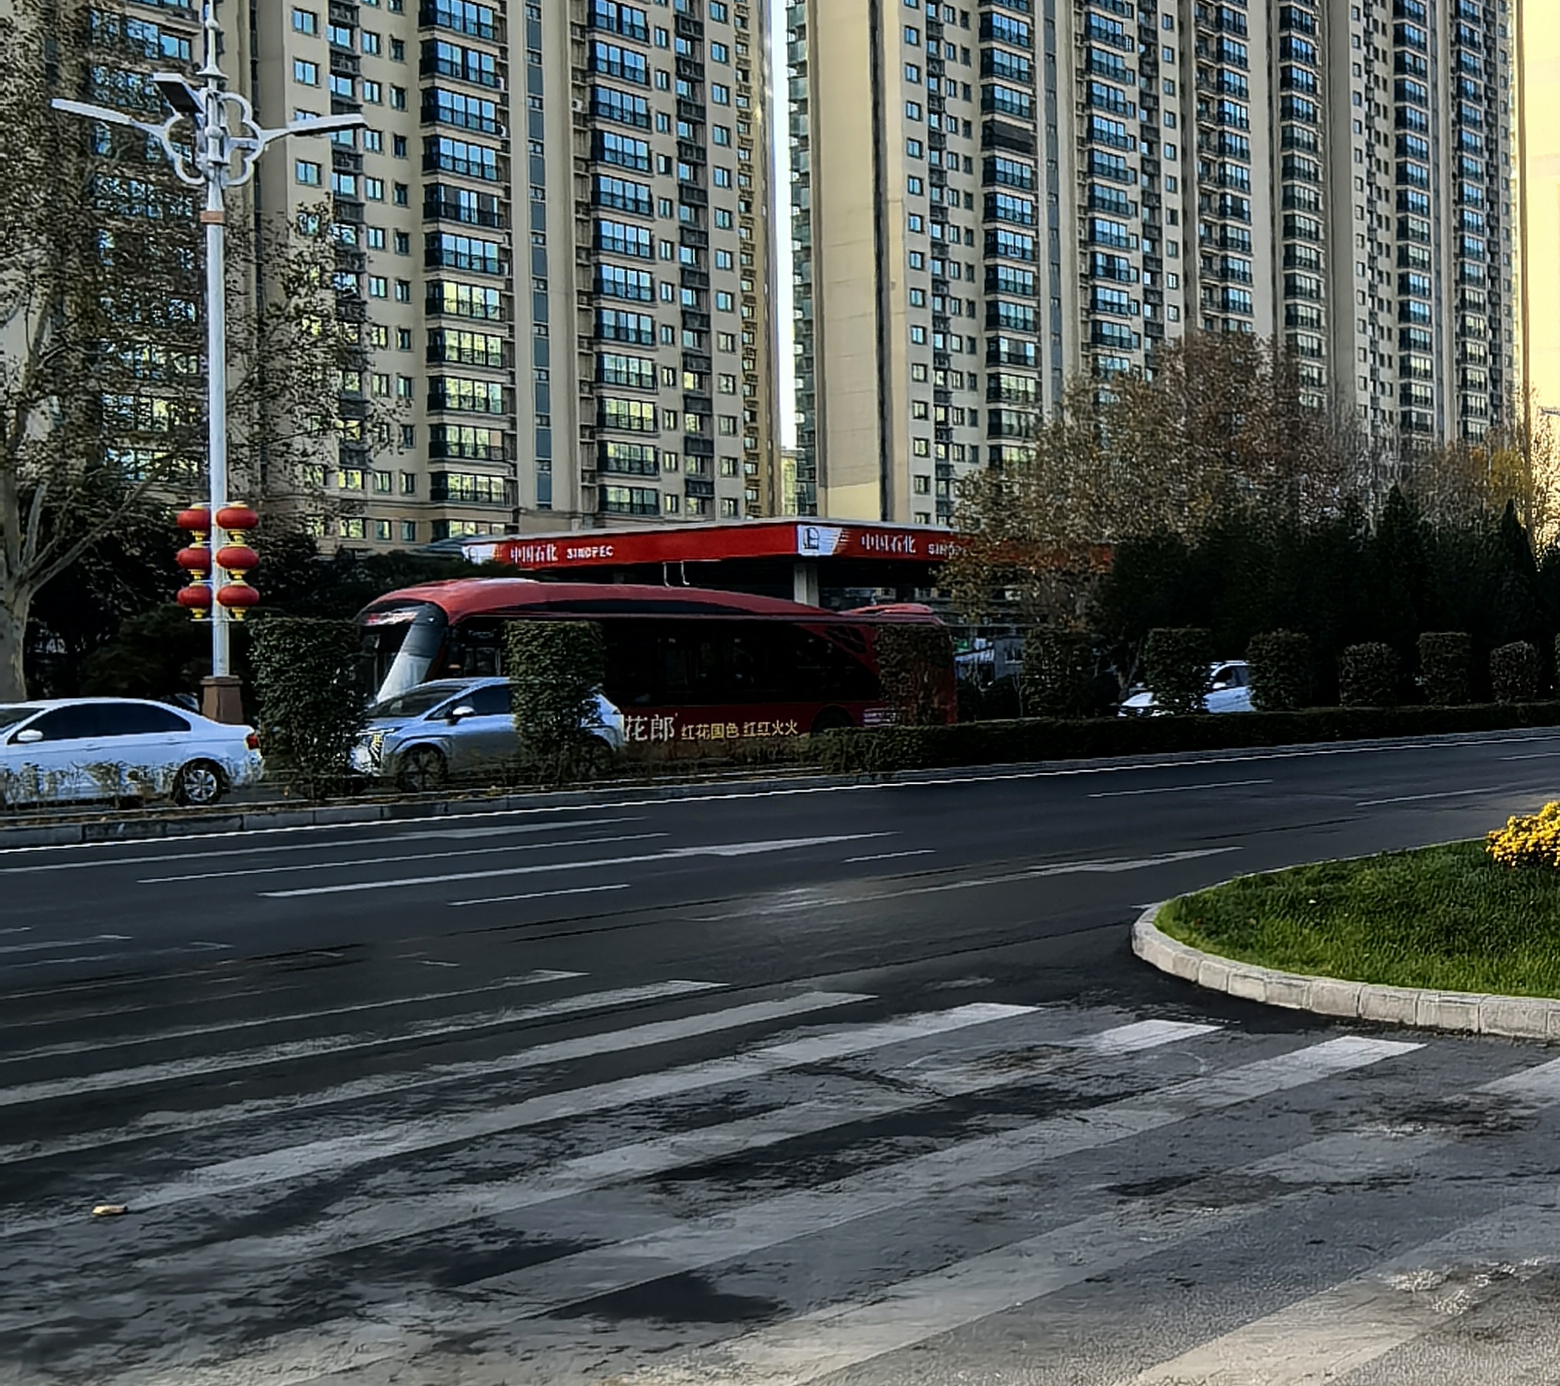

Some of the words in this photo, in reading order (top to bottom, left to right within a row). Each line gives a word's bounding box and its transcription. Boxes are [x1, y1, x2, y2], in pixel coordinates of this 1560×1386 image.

[510, 543, 559, 564] 中国石化
[566, 545, 614, 559] SINOPEC
